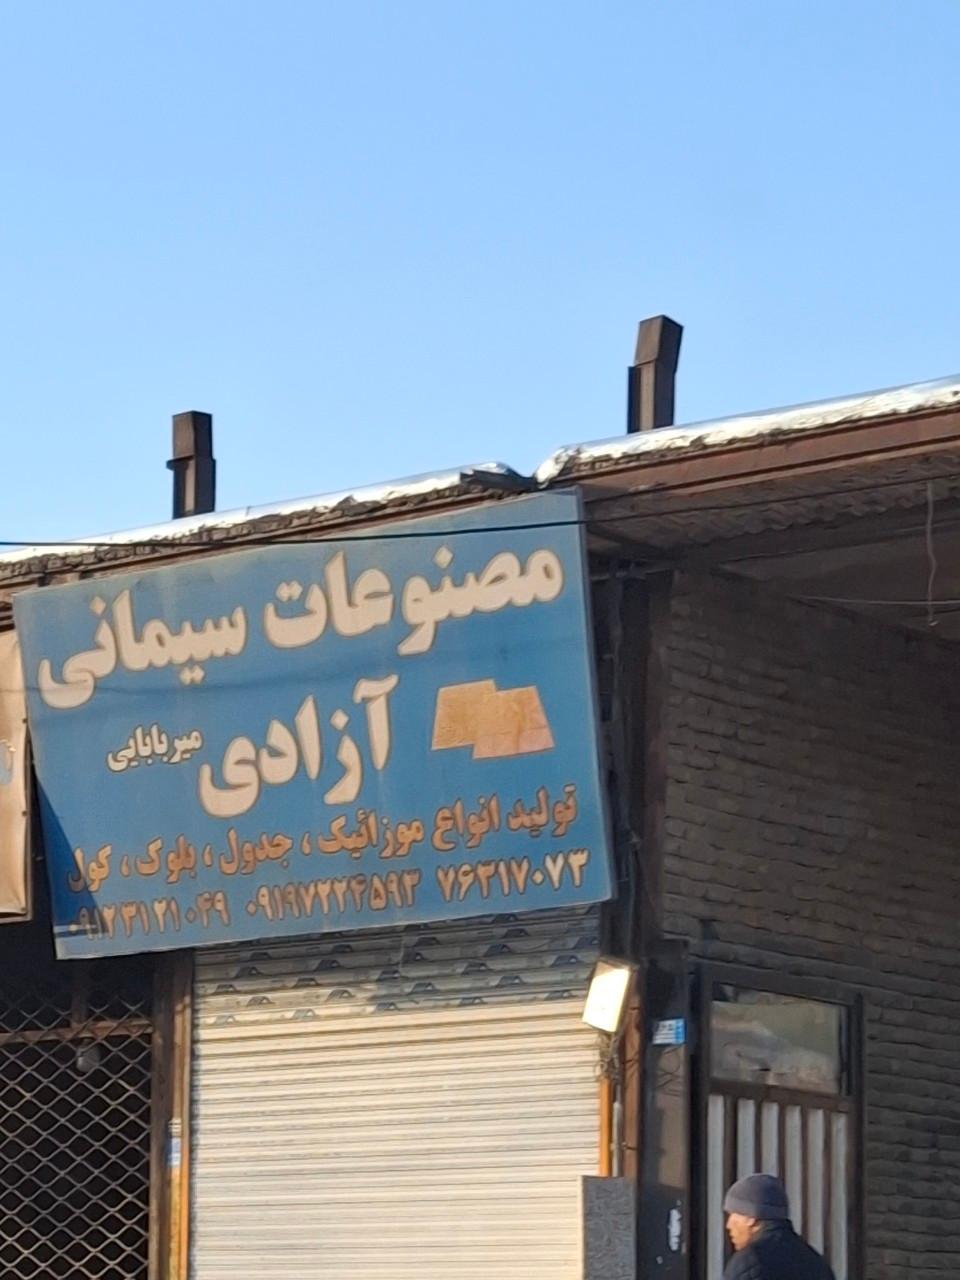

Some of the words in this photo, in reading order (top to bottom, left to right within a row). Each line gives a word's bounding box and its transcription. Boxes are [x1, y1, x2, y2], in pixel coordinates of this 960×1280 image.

[265, 545, 565, 657] مصنوعات
[39, 588, 247, 711] سیمانی
[198, 674, 400, 818] آزادی
[431, 791, 501, 852] انواع
[507, 784, 578, 839] تولید
[436, 848, 589, 903] ۷۶۳۱۷۰۷۳
